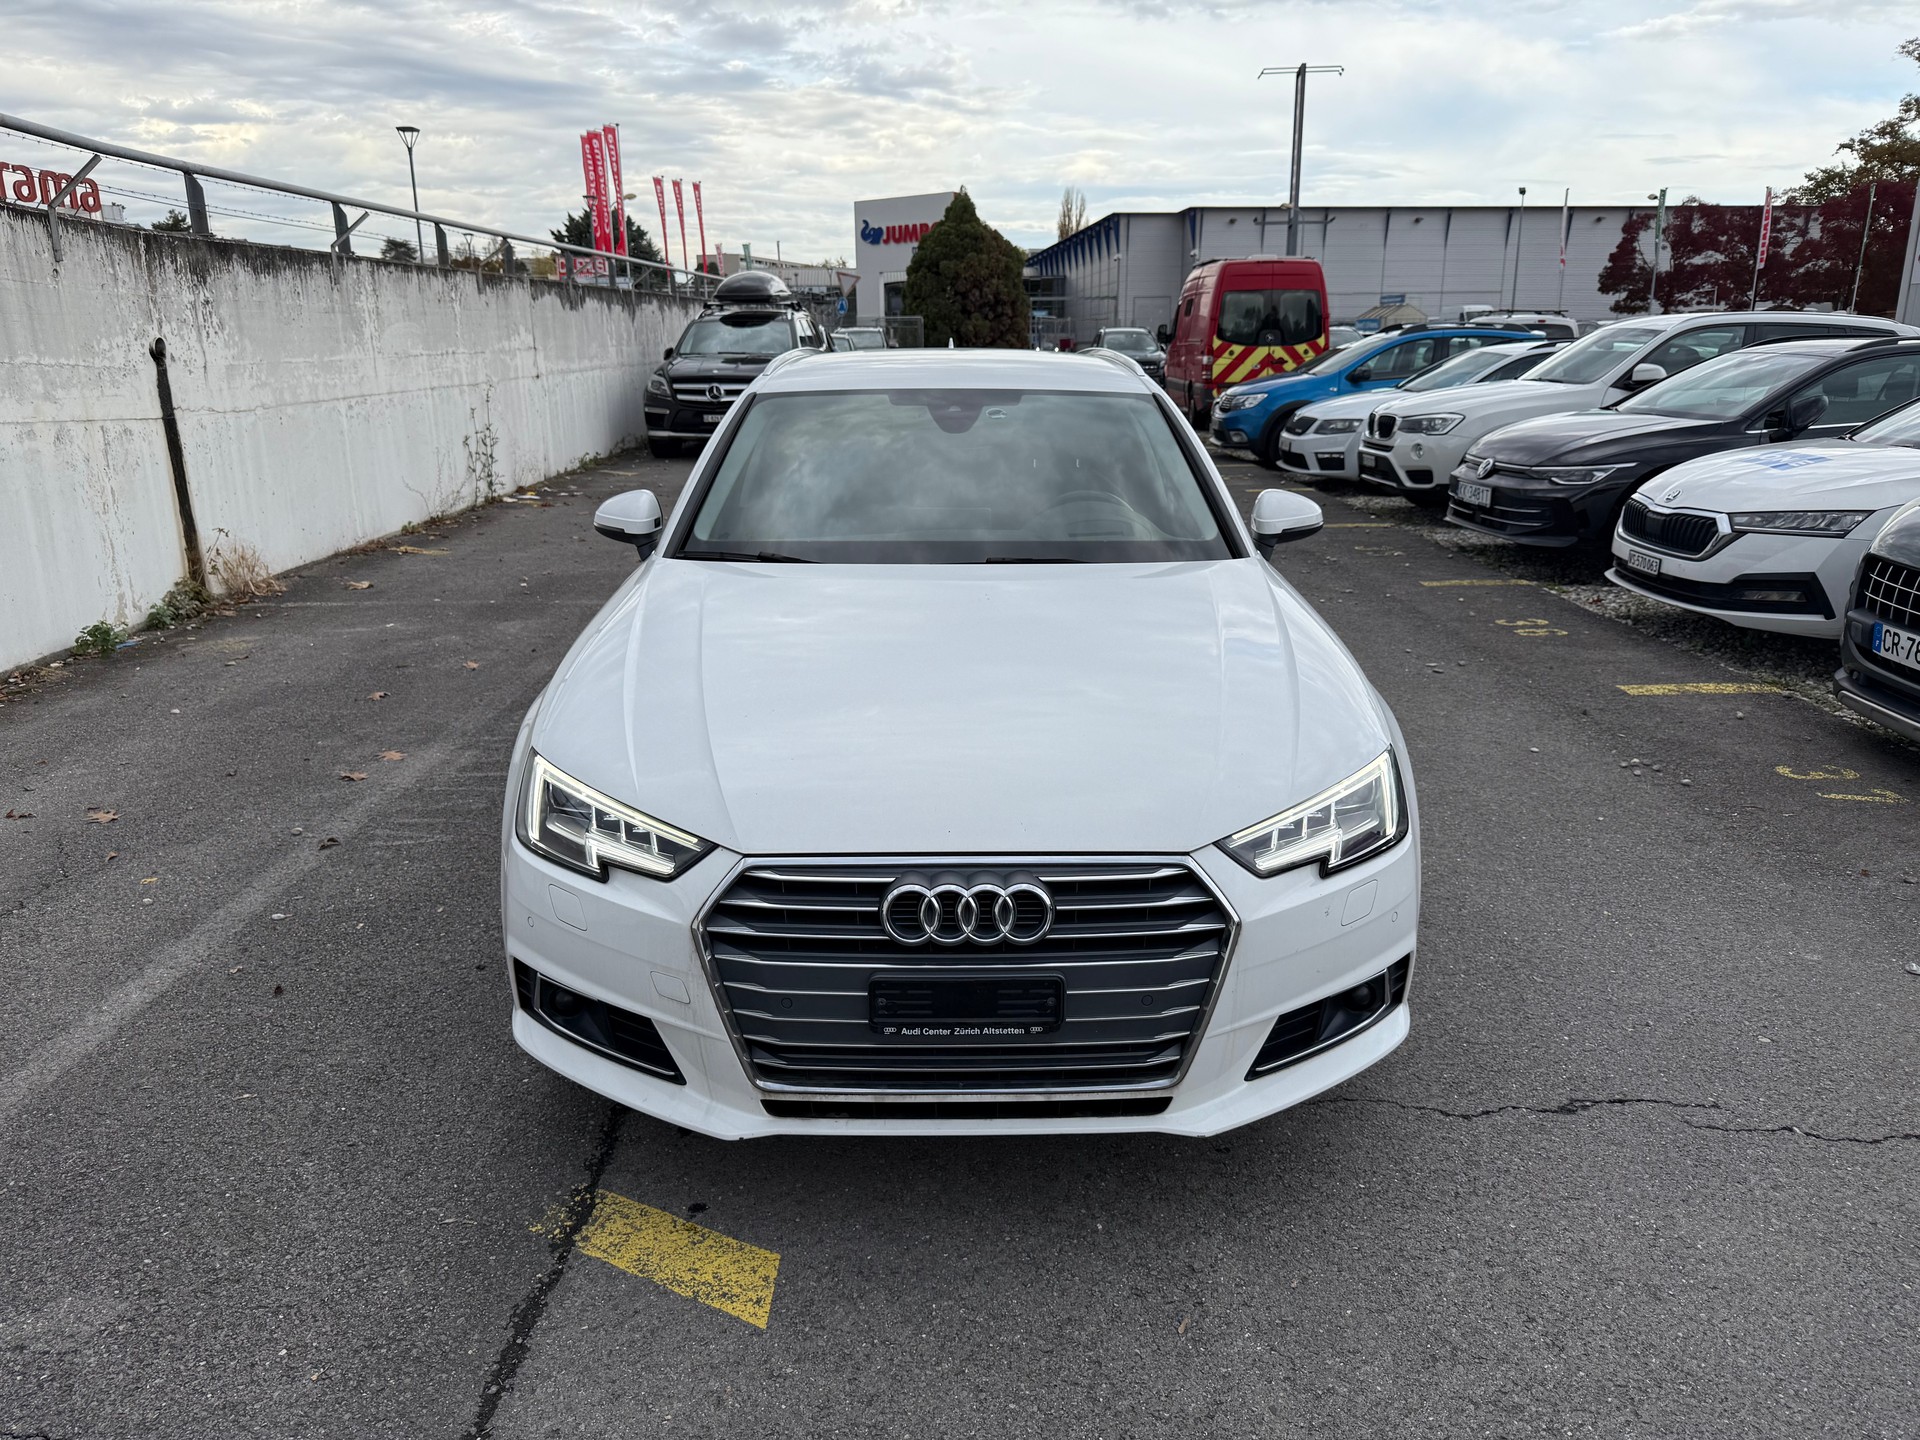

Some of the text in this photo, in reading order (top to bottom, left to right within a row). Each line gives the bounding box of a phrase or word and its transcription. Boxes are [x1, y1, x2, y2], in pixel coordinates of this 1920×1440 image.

[882, 221, 942, 245] JUMB
[901, 1026, 1025, 1035] Audi Center Zürich Altstetten
